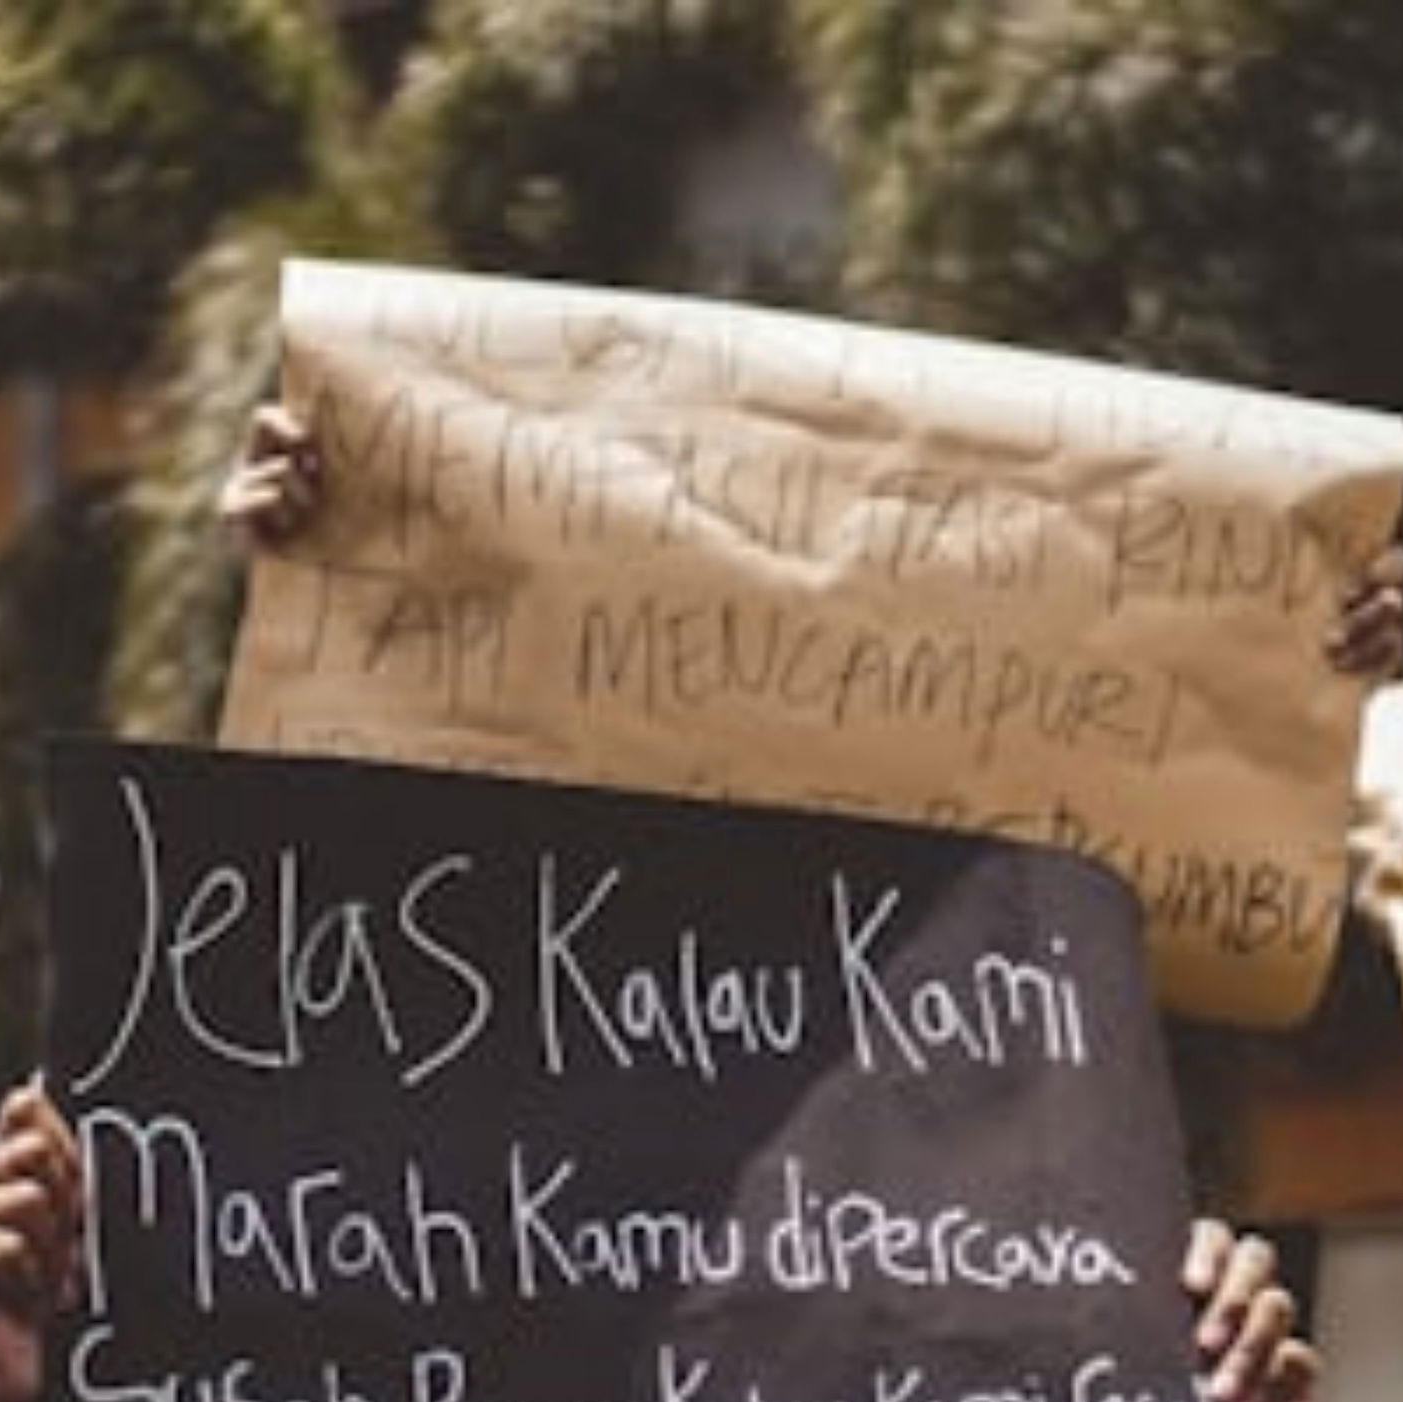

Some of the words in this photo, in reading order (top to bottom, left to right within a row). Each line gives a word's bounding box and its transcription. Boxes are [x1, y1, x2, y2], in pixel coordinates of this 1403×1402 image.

[576, 597, 1180, 766] MENCAMPURI
[538, 852, 801, 1084] Kalau
[832, 868, 1088, 1073] Kami
[74, 1106, 482, 1316] Marah
[510, 1144, 746, 1300] Kamu
